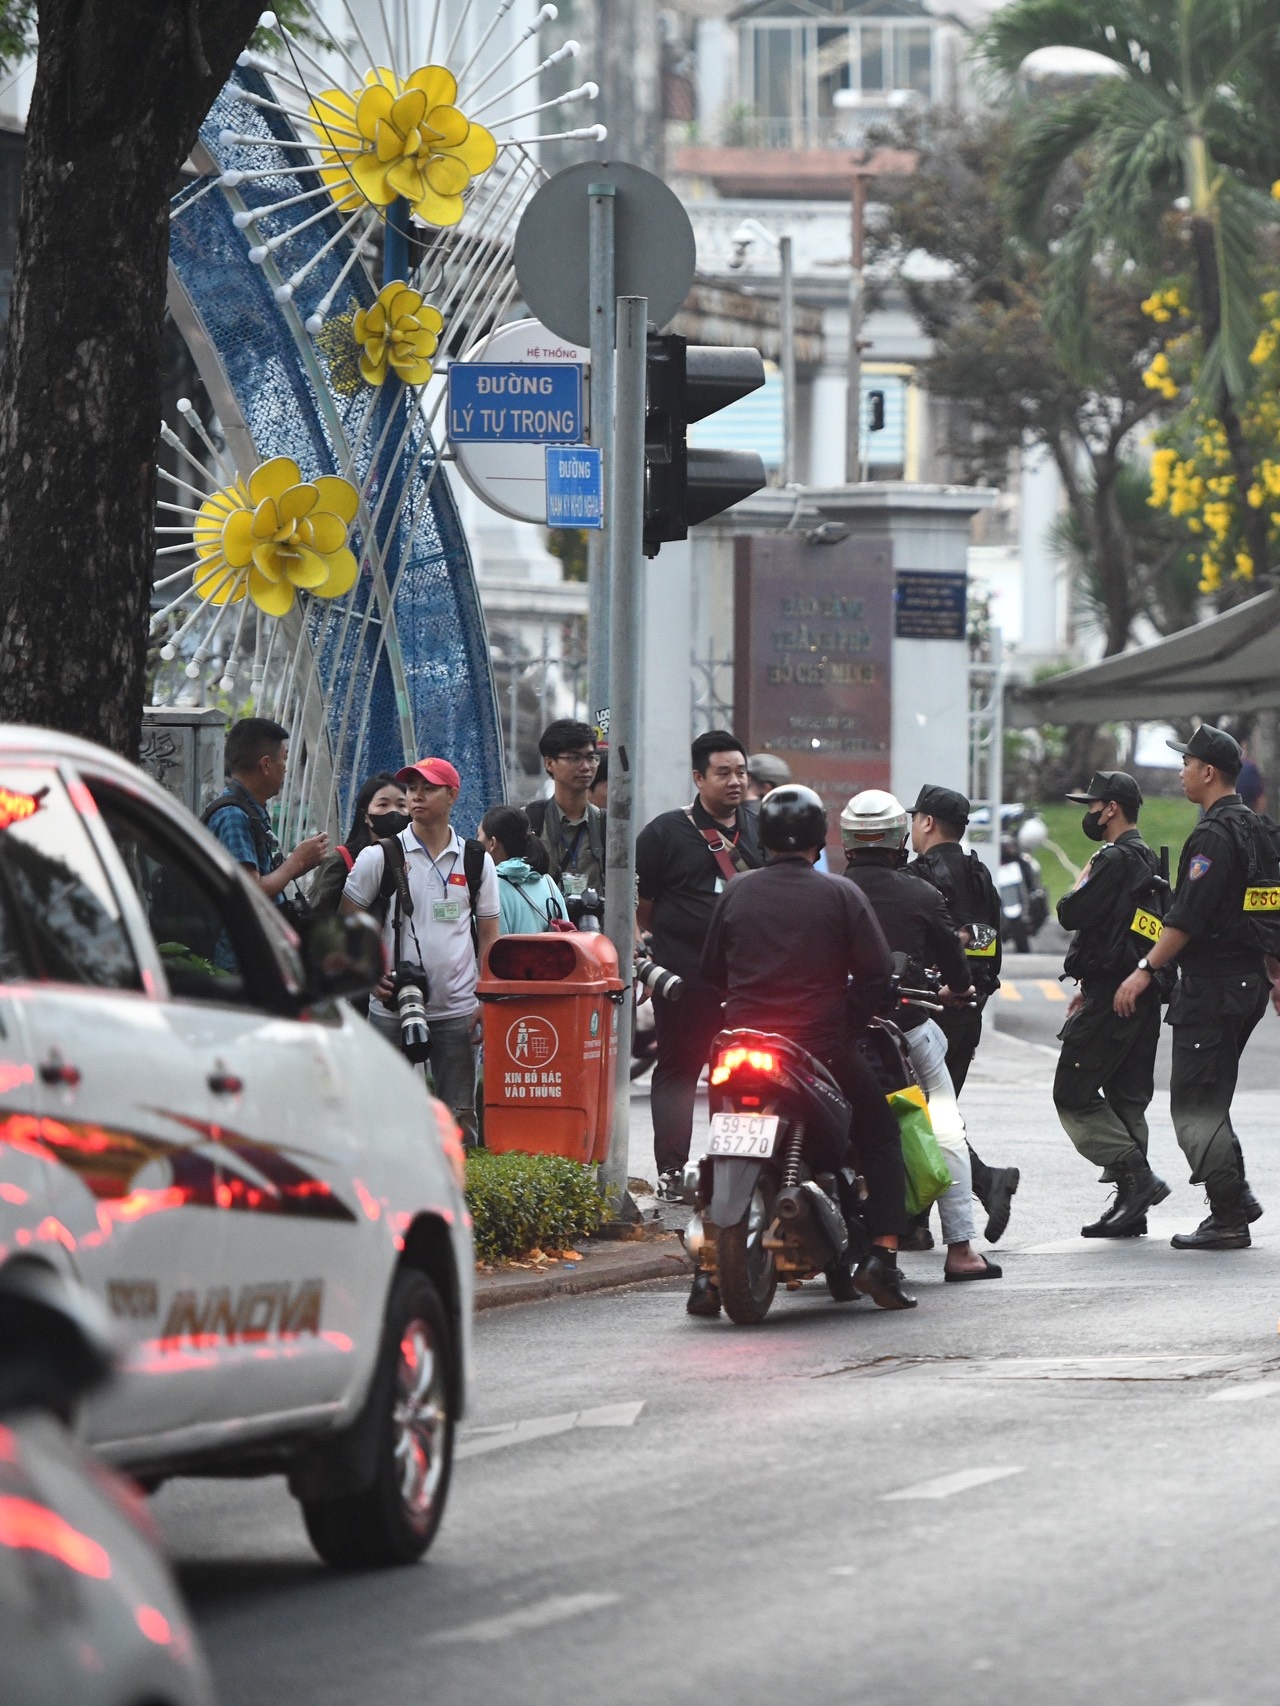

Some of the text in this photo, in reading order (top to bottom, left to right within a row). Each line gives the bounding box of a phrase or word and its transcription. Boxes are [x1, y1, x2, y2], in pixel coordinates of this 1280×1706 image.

[527, 346, 577, 359] HỆ THỐNG
[477, 372, 553, 395] ĐƯỜNG
[453, 403, 574, 438] LÝ TỰ TRỌNG
[558, 457, 591, 479] ĐƯỜNG
[504, 1069, 562, 1084] XIN BỎ RÁC
[504, 1084, 562, 1098] VÀO THÙNG
[721, 1117, 766, 1135] 59-C1
[711, 1135, 769, 1154] 657.70
[160, 1277, 325, 1353] INNOVA
